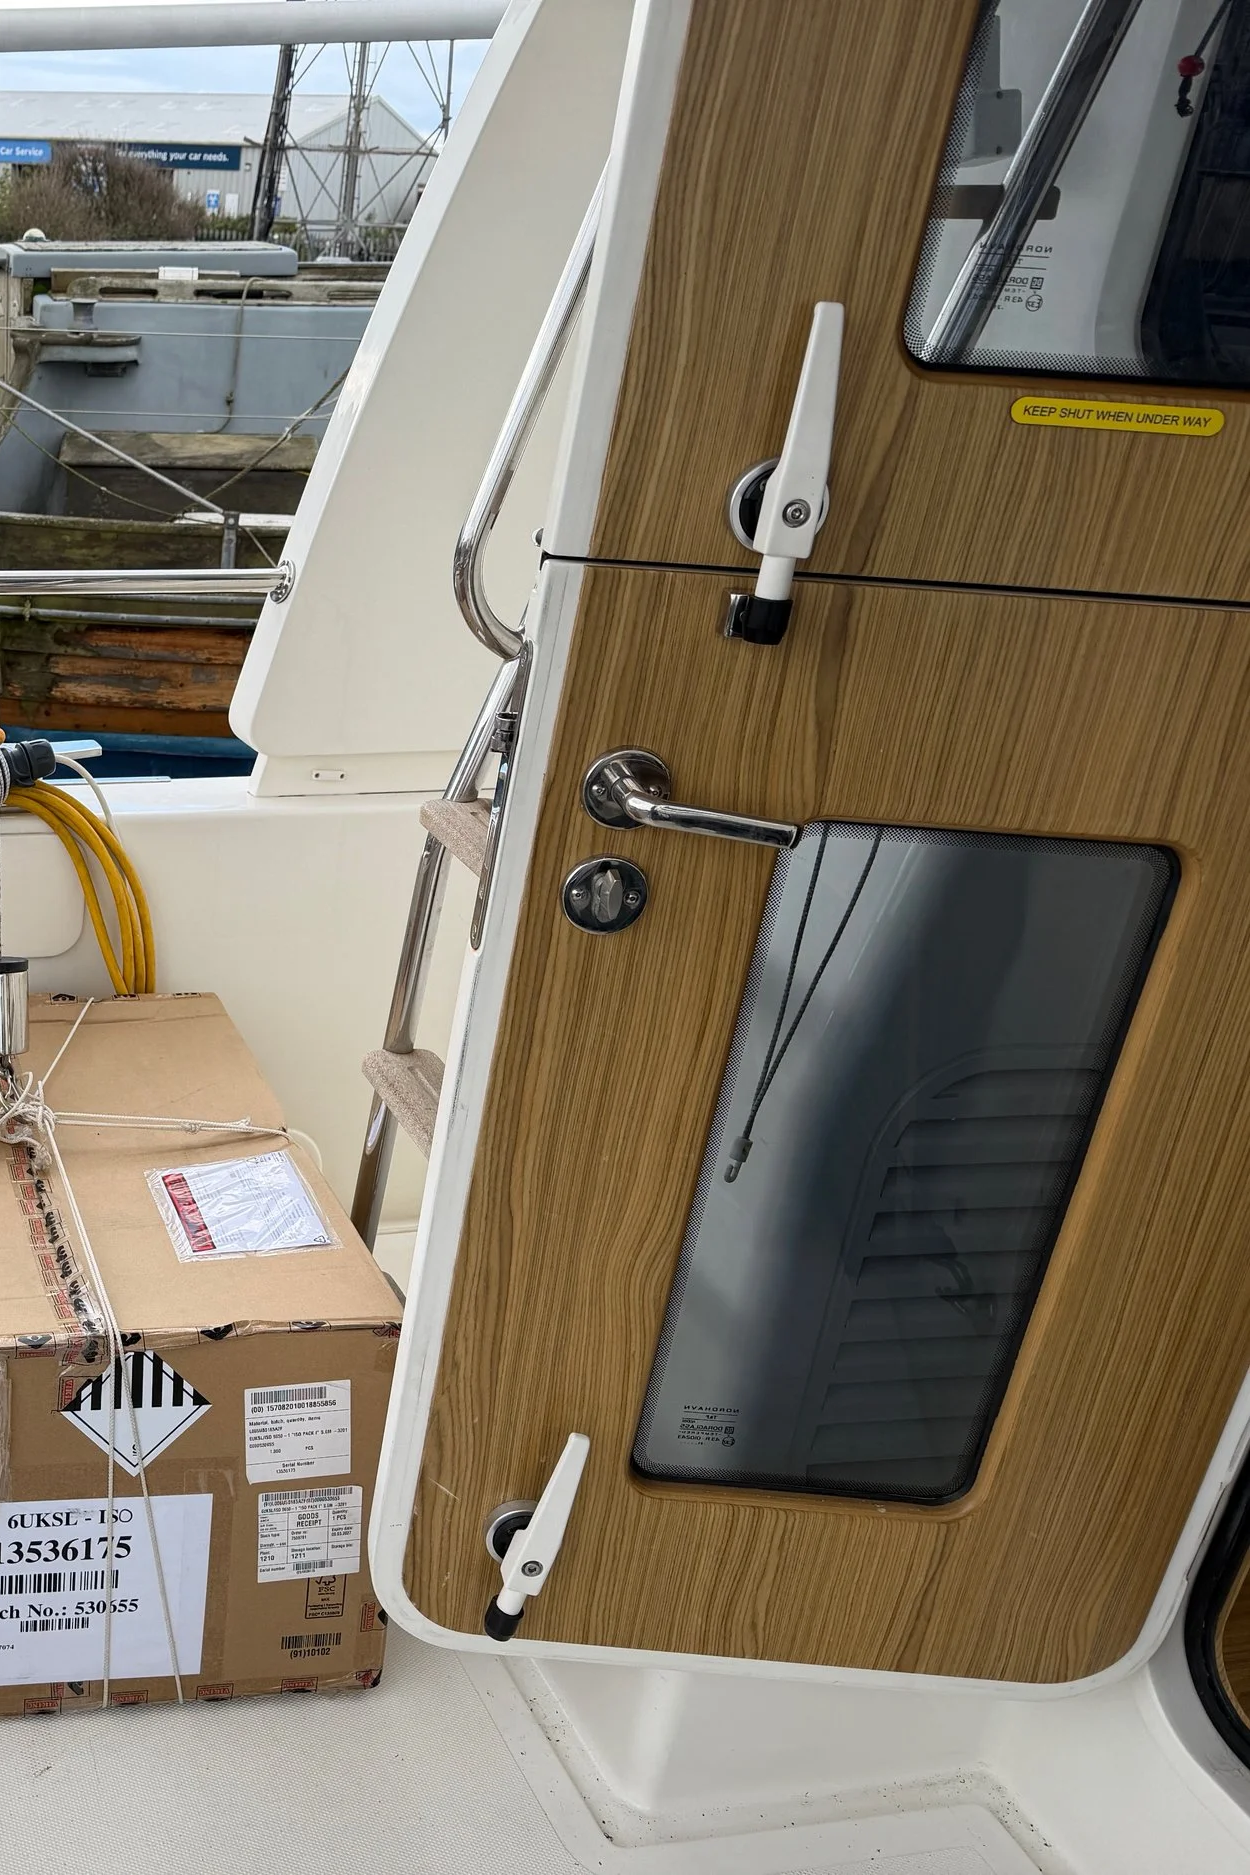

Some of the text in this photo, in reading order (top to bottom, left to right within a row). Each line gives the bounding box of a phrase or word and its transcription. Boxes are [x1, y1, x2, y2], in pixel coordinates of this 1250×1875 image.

[0, 146, 13, 156] Car
[15, 146, 44, 156] Service
[169, 151, 186, 162] your
[188, 152, 202, 160] car
[1023, 405, 1211, 428] KEEP SHUT WHEN UNDER WAY
[7, 1510, 79, 1530] 6UKSL
[98, 1507, 134, 1526] ISO
[297, 1512, 319, 1520] GOODS
[296, 1519, 322, 1527] RECEIPT
[318, 1585, 336, 1593] FSC
[27, 1602, 67, 1619] No.:
[74, 1598, 139, 1616] 530655
[289, 1647, 331, 1660] (91)10102
